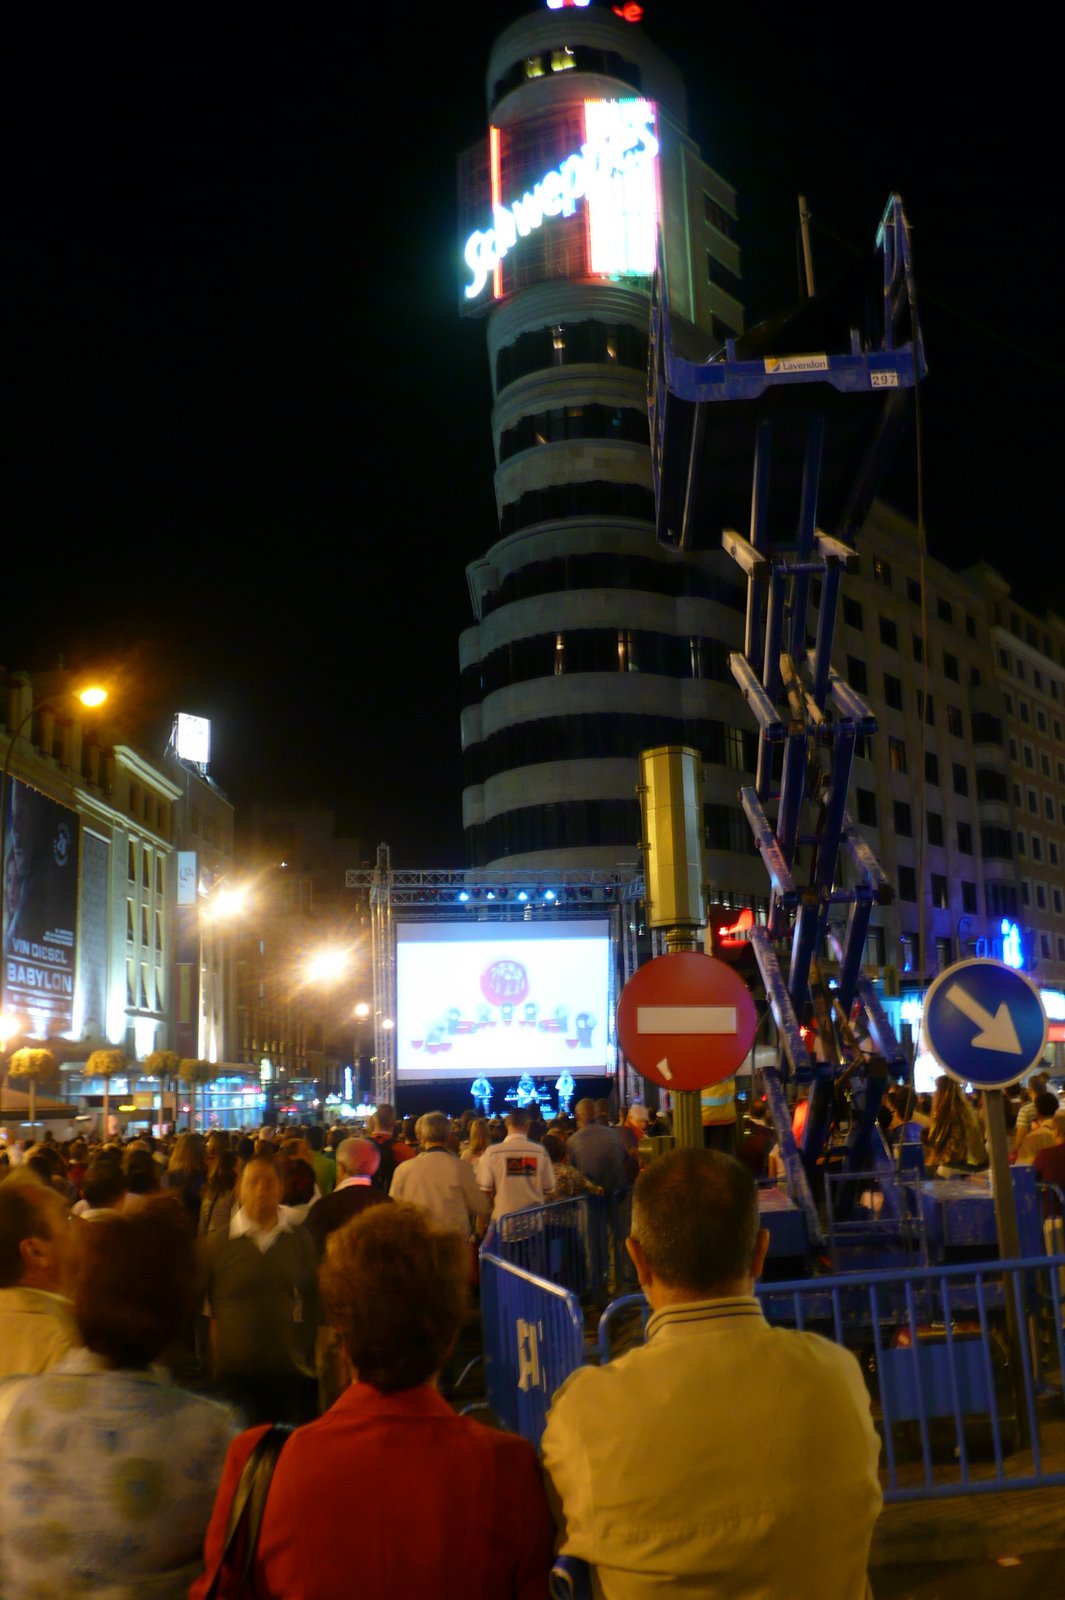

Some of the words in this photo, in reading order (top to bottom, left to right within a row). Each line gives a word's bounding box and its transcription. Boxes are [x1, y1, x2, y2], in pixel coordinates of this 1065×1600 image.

[782, 359, 826, 371] Lavendon
[872, 374, 897, 386] 297
[12, 938, 30, 955] VIN
[31, 943, 68, 964] DIESEL
[6, 962, 73, 993] BABYLON
